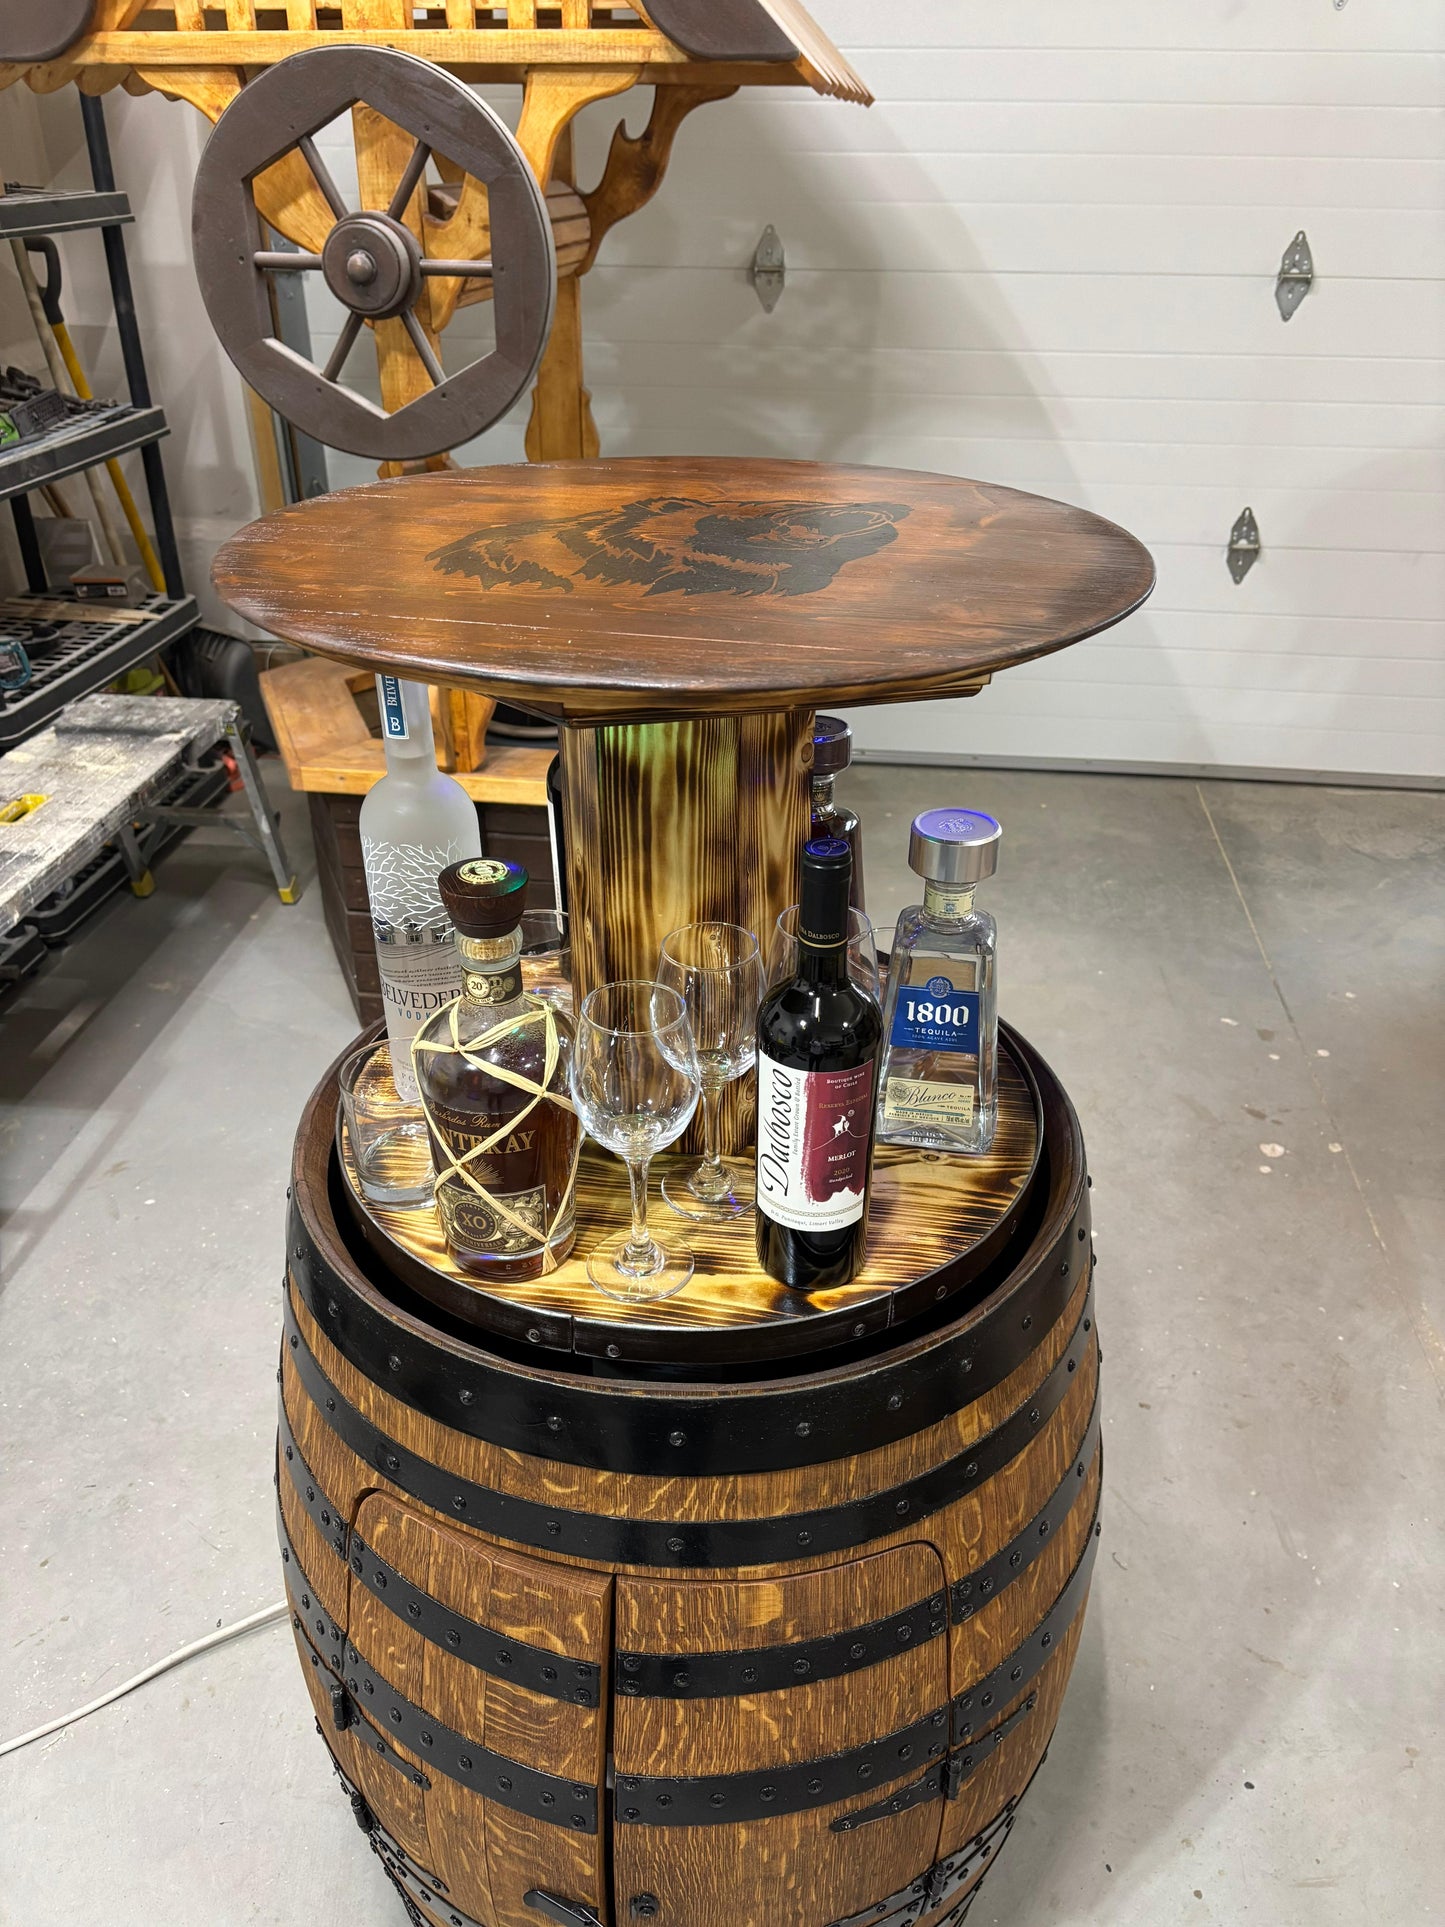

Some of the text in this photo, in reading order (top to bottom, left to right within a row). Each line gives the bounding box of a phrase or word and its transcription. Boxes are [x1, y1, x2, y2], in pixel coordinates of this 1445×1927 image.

[385, 675, 398, 706] BELVE
[471, 981, 483, 991] 20
[906, 1000, 969, 1027] 1800
[914, 1027, 957, 1037] TEQUILA
[902, 1085, 956, 1106] Blanco
[470, 1114, 501, 1128] Rum
[760, 1068, 792, 1197] Dalbosco
[827, 1150, 857, 1162] MERLOT
[833, 1167, 850, 1176] 2020
[460, 1211, 487, 1230] XO
